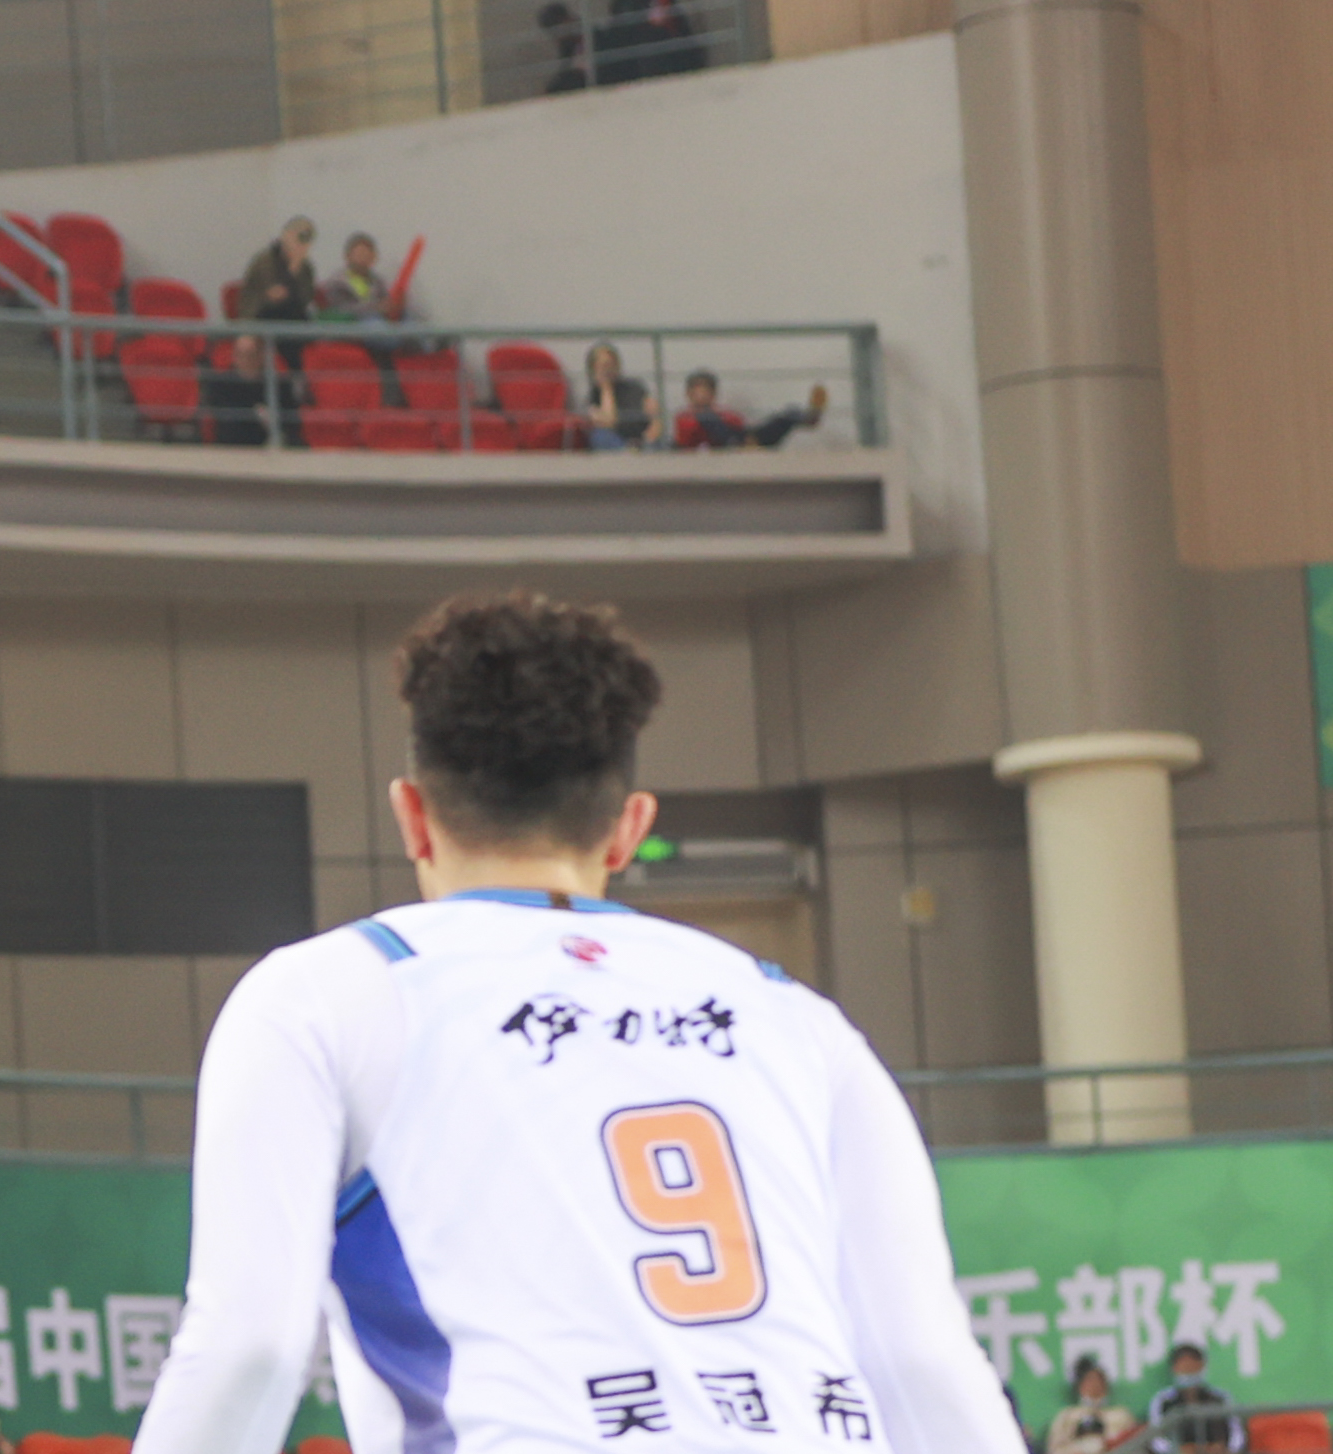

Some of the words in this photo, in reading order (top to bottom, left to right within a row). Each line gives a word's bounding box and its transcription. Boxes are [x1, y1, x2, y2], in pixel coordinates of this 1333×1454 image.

[601, 1100, 768, 1327] 9
[586, 1369, 873, 1442] 吴冠希
